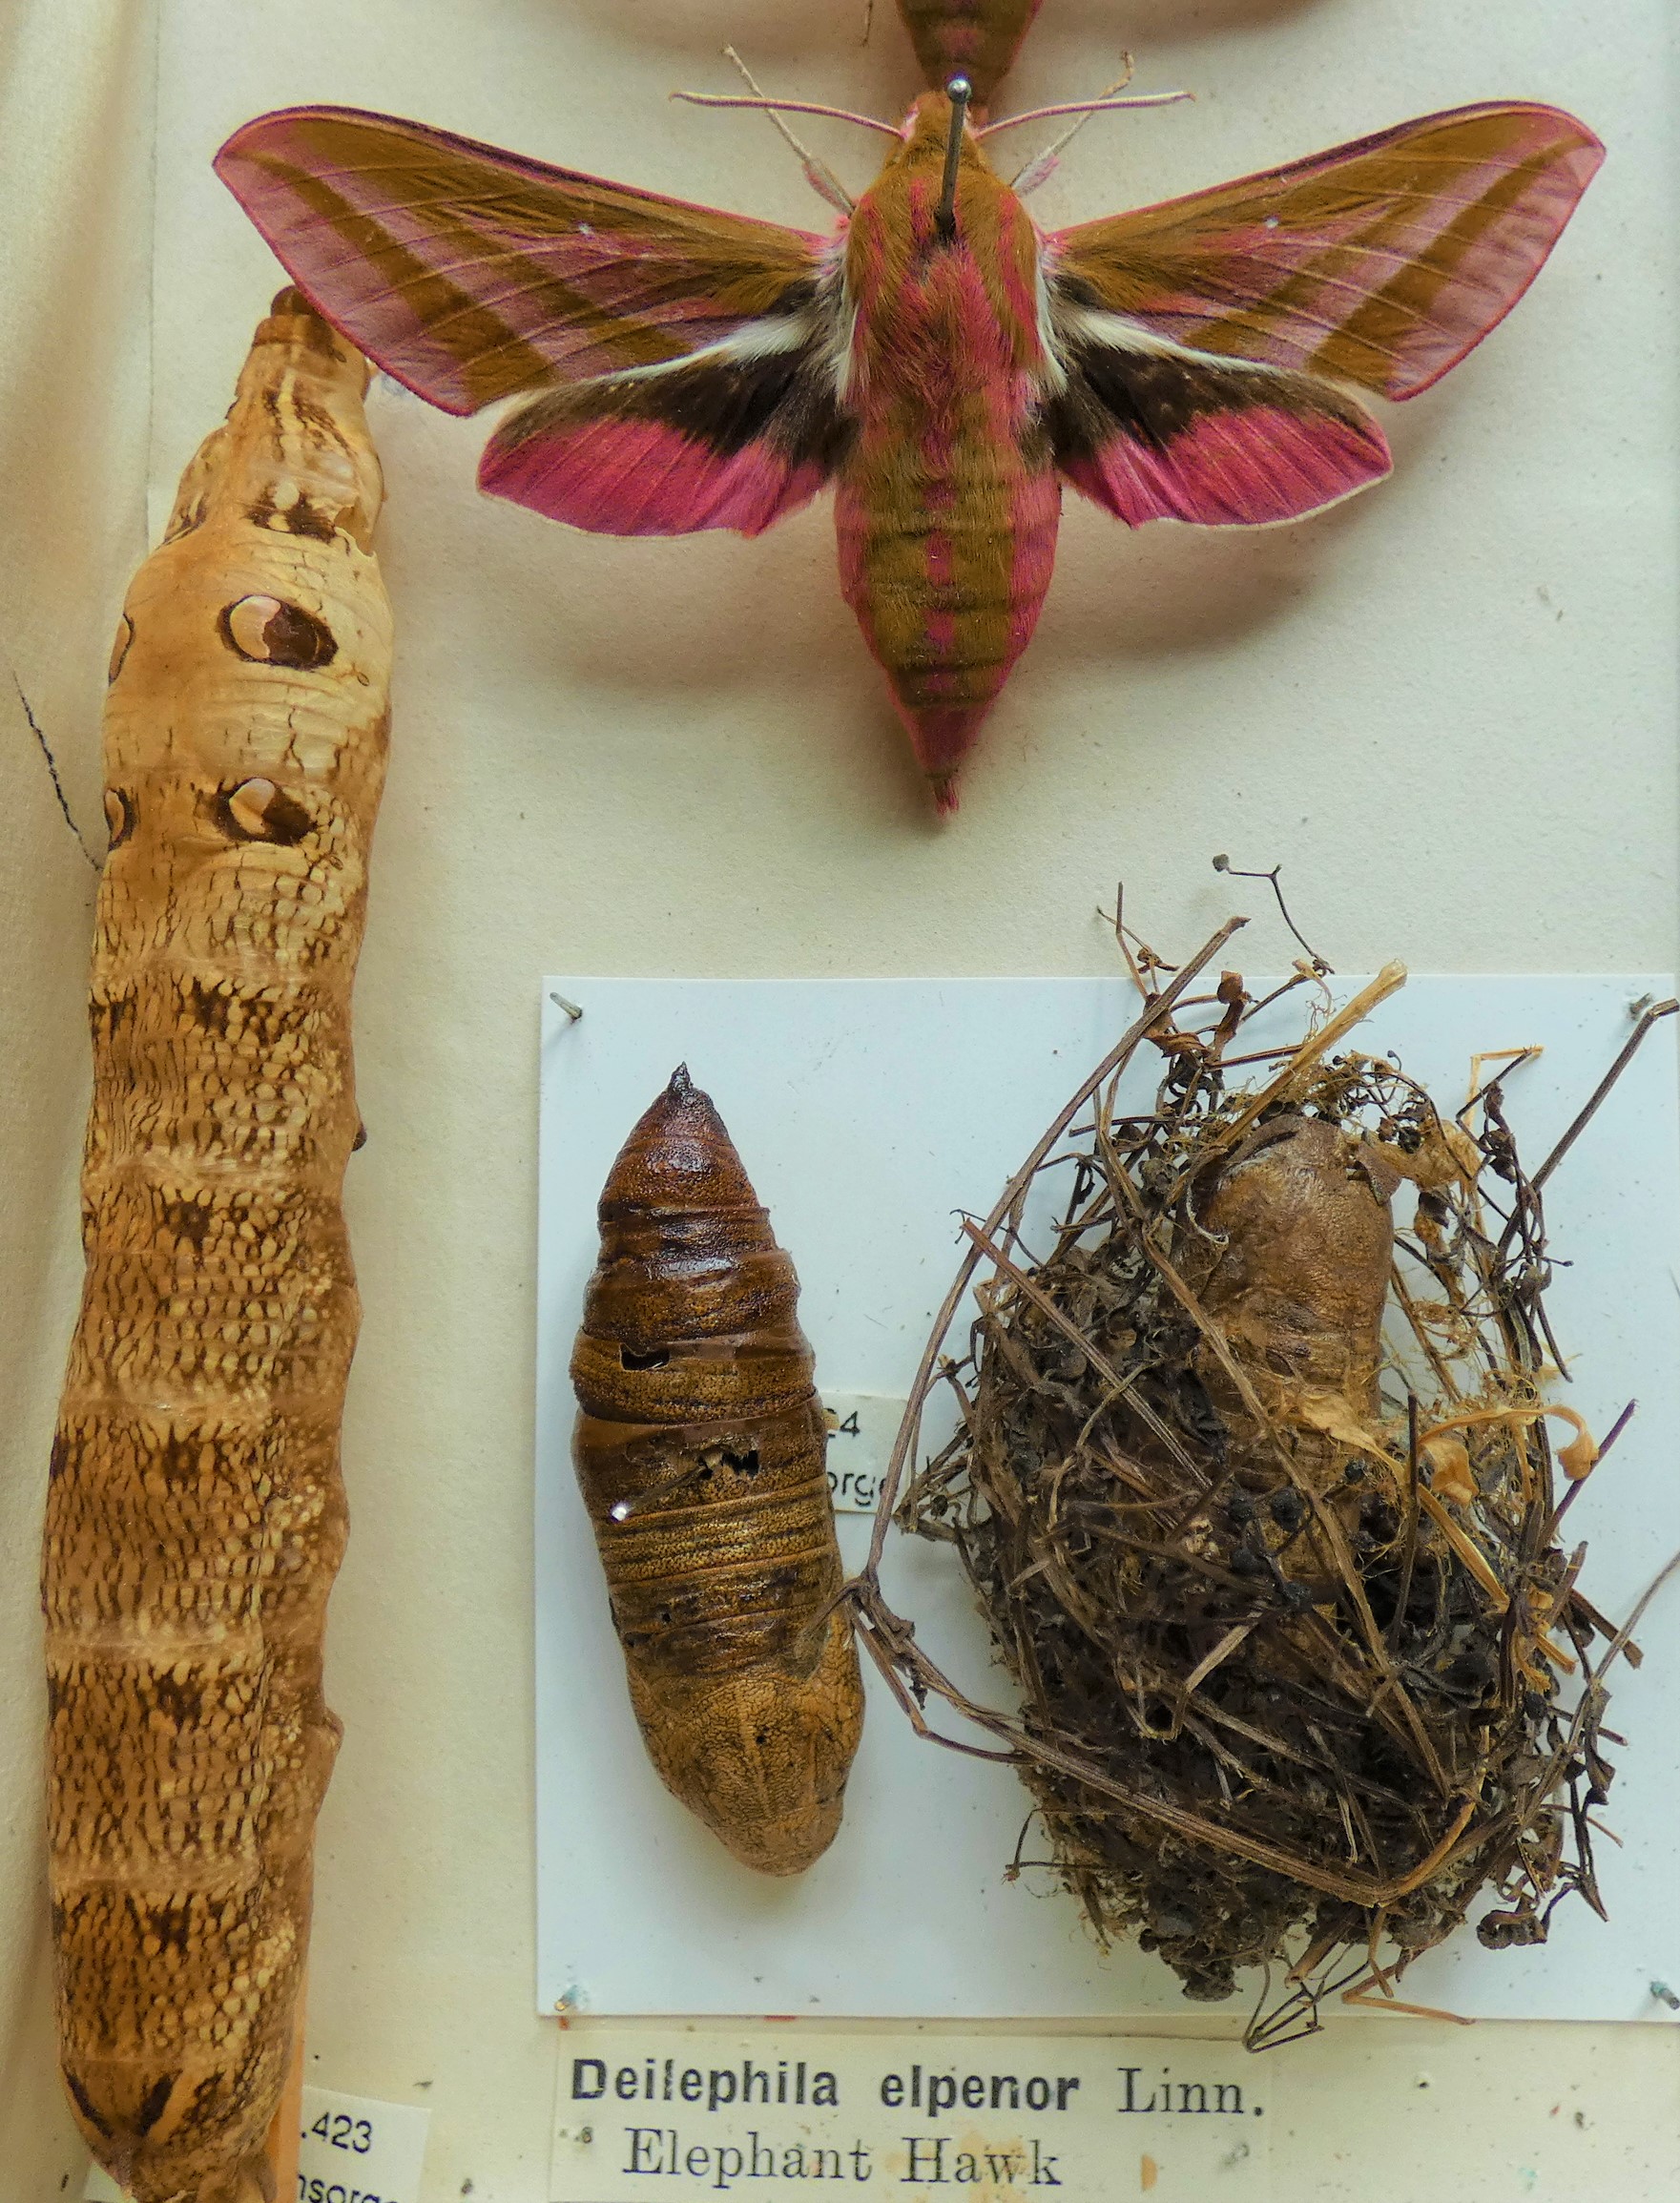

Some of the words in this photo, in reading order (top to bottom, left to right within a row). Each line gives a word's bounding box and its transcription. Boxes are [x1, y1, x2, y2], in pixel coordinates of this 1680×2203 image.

[570, 2057, 839, 2112] Deilephila
[880, 2065, 1081, 2118] elpenor
[1116, 2067, 1265, 2117] Linn.
[622, 2127, 873, 2190] Elephant
[900, 2136, 1063, 2186] Hawk
